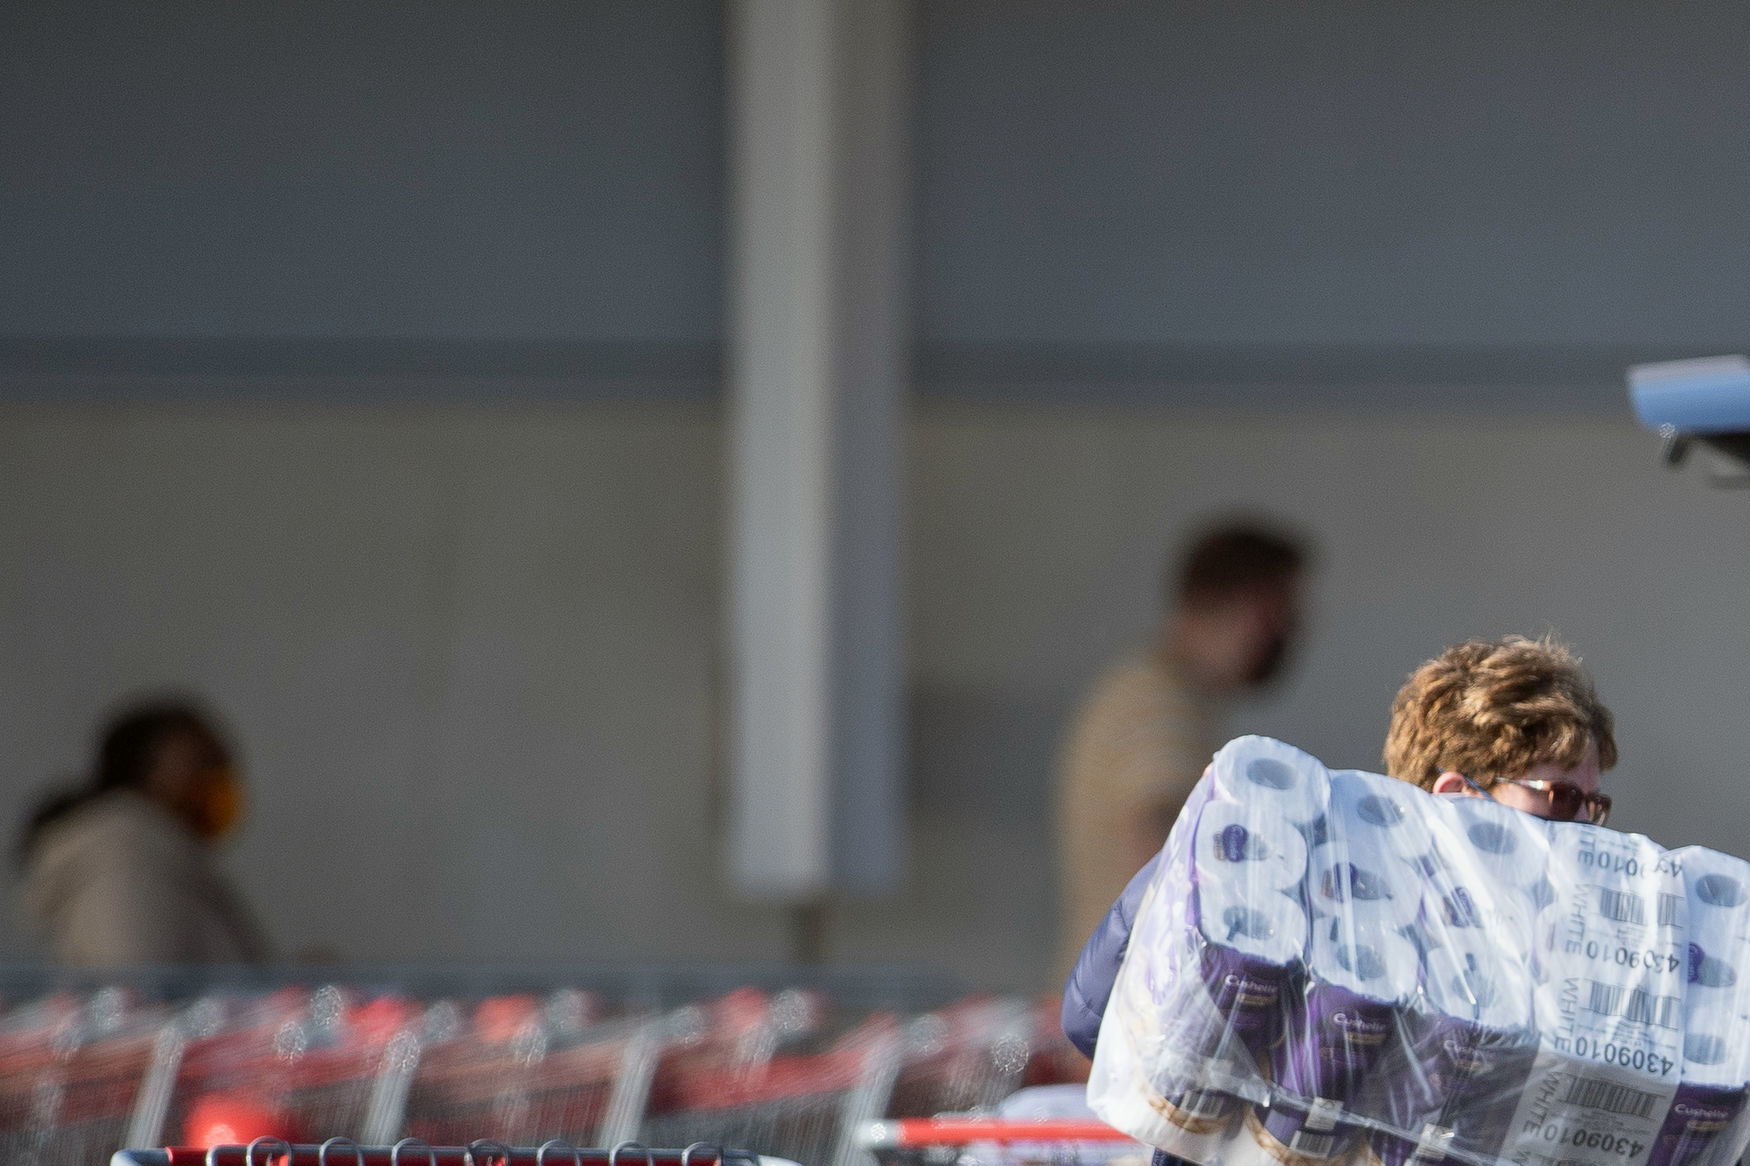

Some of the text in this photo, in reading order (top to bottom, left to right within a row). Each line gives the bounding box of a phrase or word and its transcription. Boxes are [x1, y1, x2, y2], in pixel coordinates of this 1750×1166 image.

[1565, 883, 1590, 955] WHITE
[1554, 977, 1579, 1053] WHITE
[1575, 1036, 1674, 1076] 4309010
[1522, 1070, 1560, 1137] WHITE
[1544, 1123, 1645, 1158] 4309010
